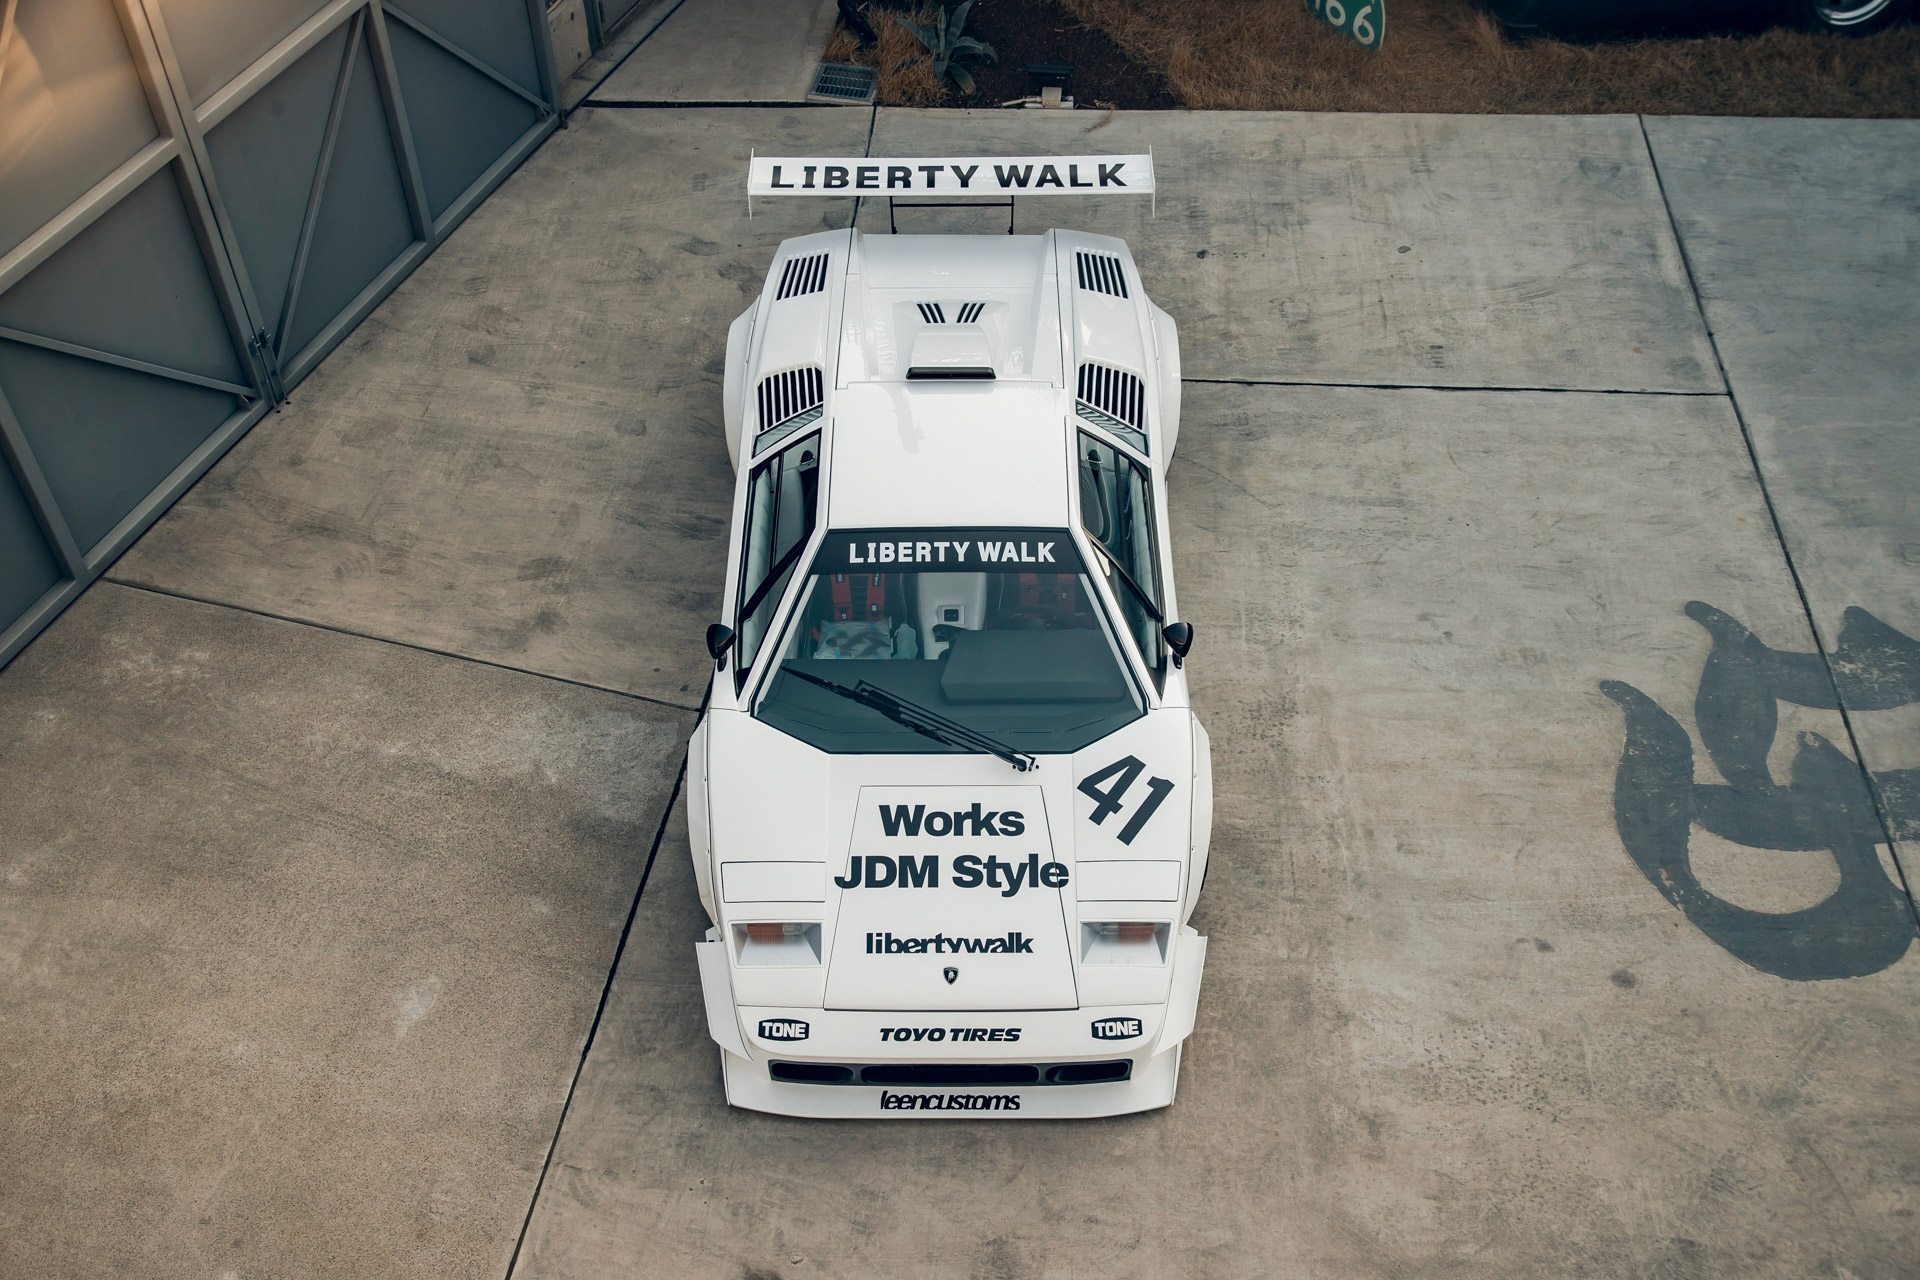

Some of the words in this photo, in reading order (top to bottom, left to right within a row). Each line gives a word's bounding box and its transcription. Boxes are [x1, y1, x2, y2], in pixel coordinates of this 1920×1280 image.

[1314, 0, 1375, 45] 66
[770, 165, 980, 189] LIBERTY
[993, 163, 1128, 188] WALK
[849, 541, 970, 564] LIBERTY
[977, 541, 1056, 563] WALK
[1076, 754, 1175, 846] 41
[878, 802, 1026, 837] Works
[834, 855, 939, 890] JDM
[952, 853, 1070, 898] Style
[866, 932, 1034, 954] libertywalk
[762, 1022, 806, 1038] TONE
[879, 1027, 947, 1042] TOYO
[949, 1027, 1022, 1042] TIRES
[1094, 1020, 1140, 1037] TONE
[880, 1090, 1021, 1111] leencustoms
